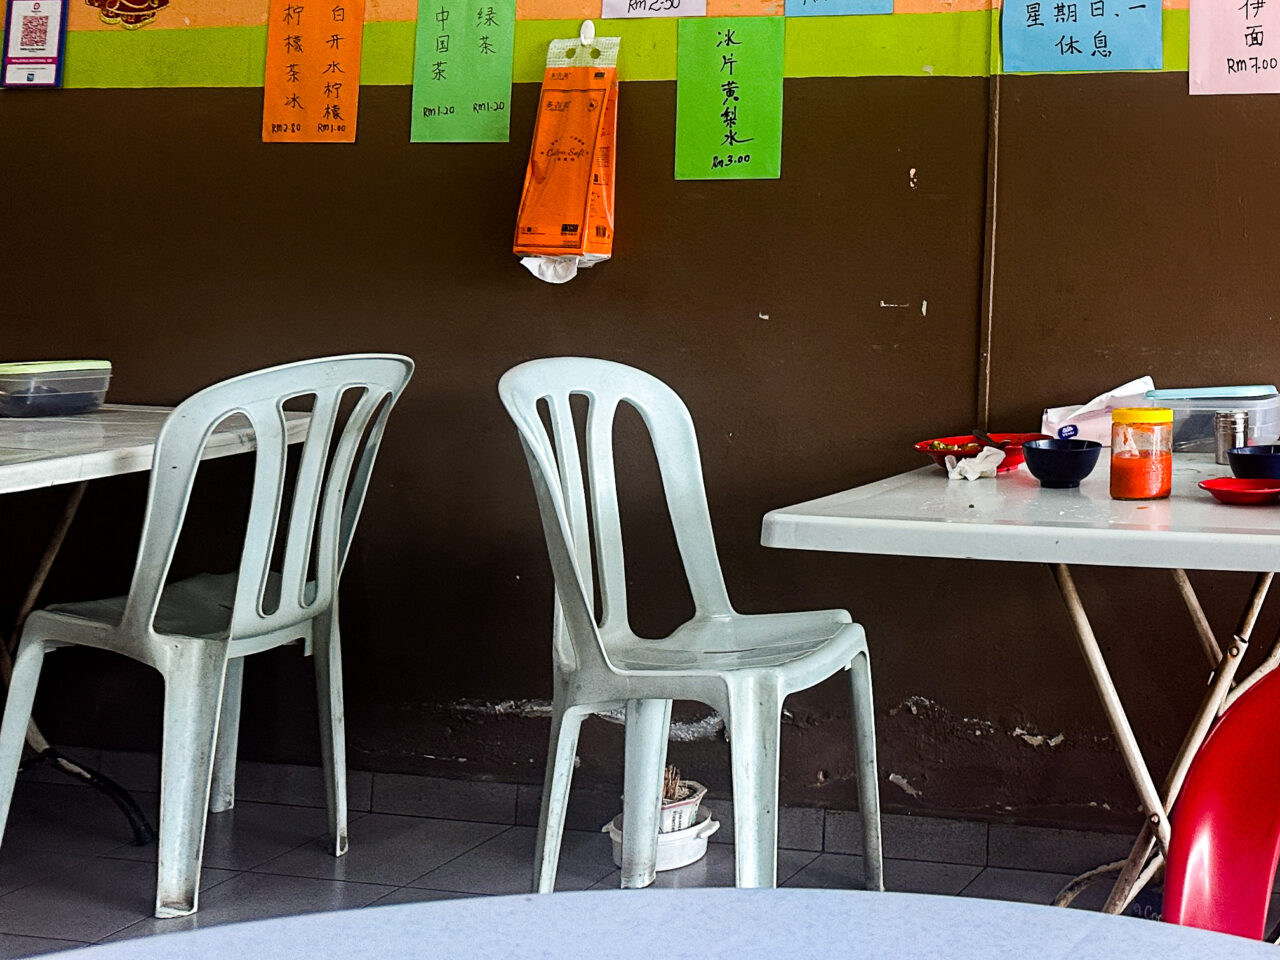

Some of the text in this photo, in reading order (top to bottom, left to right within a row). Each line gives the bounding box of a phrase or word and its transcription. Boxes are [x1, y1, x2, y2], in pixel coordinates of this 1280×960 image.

[432, 6, 450, 81] 中国茶
[476, 7, 499, 54] 绿茶
[1055, 30, 1113, 58] 休息
